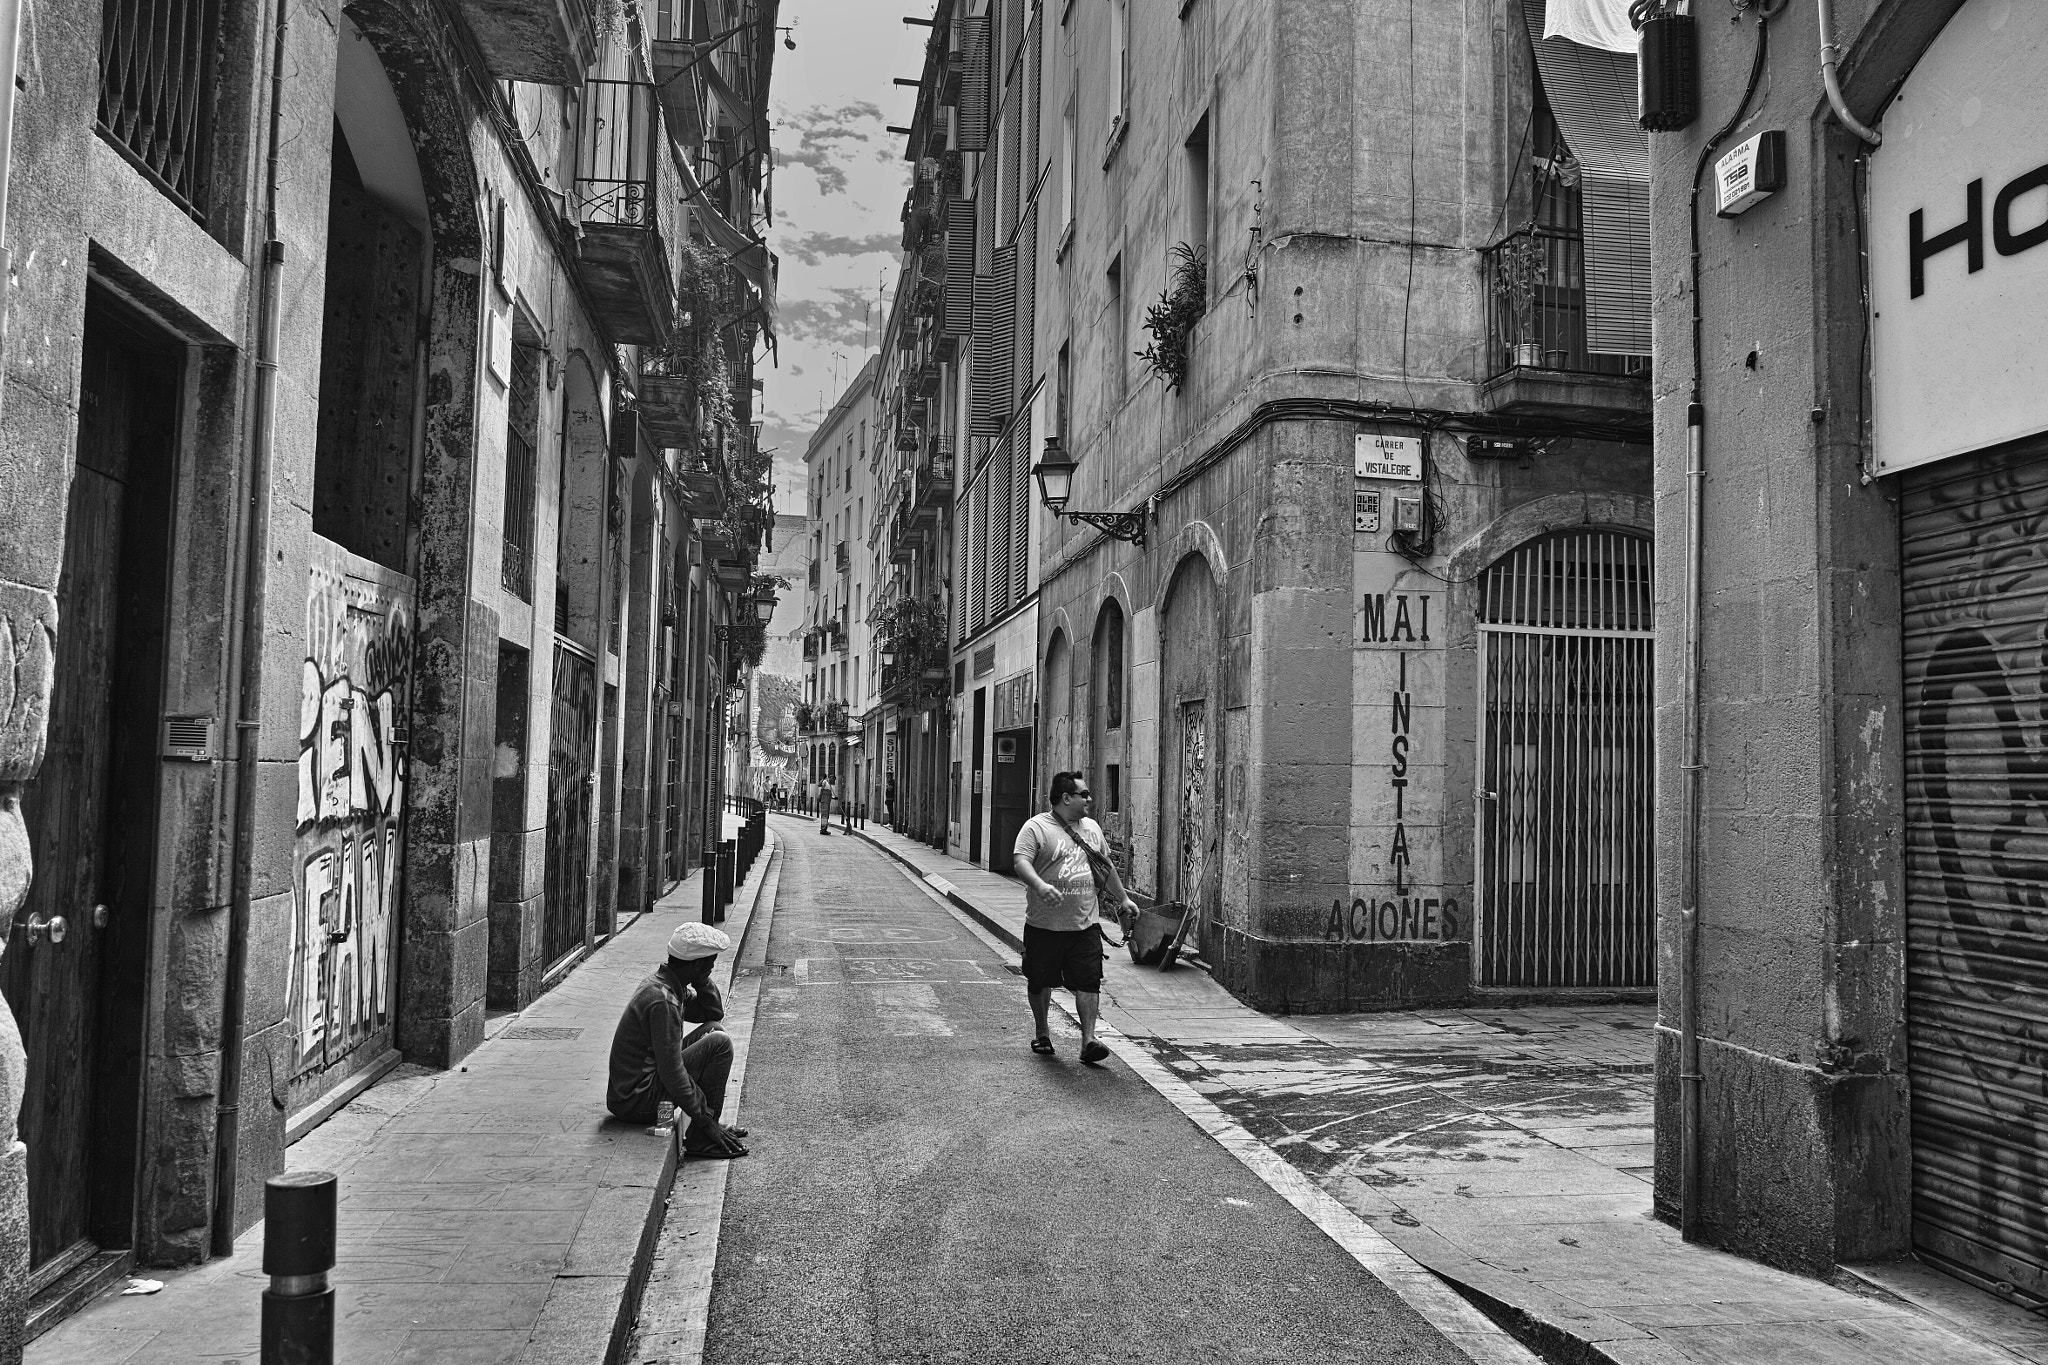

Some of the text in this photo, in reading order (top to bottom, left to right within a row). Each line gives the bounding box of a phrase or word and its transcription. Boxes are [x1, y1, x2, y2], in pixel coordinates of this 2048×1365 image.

[1720, 143, 1750, 168] ALARMA
[1375, 439, 1404, 449] CARRER
[1385, 452, 1394, 461] DE
[1365, 462, 1412, 476] VISTALEGRE
[1362, 593, 1430, 643] MAI
[886, 738, 894, 772] SUPER
[1325, 897, 1459, 940] ACIONES
